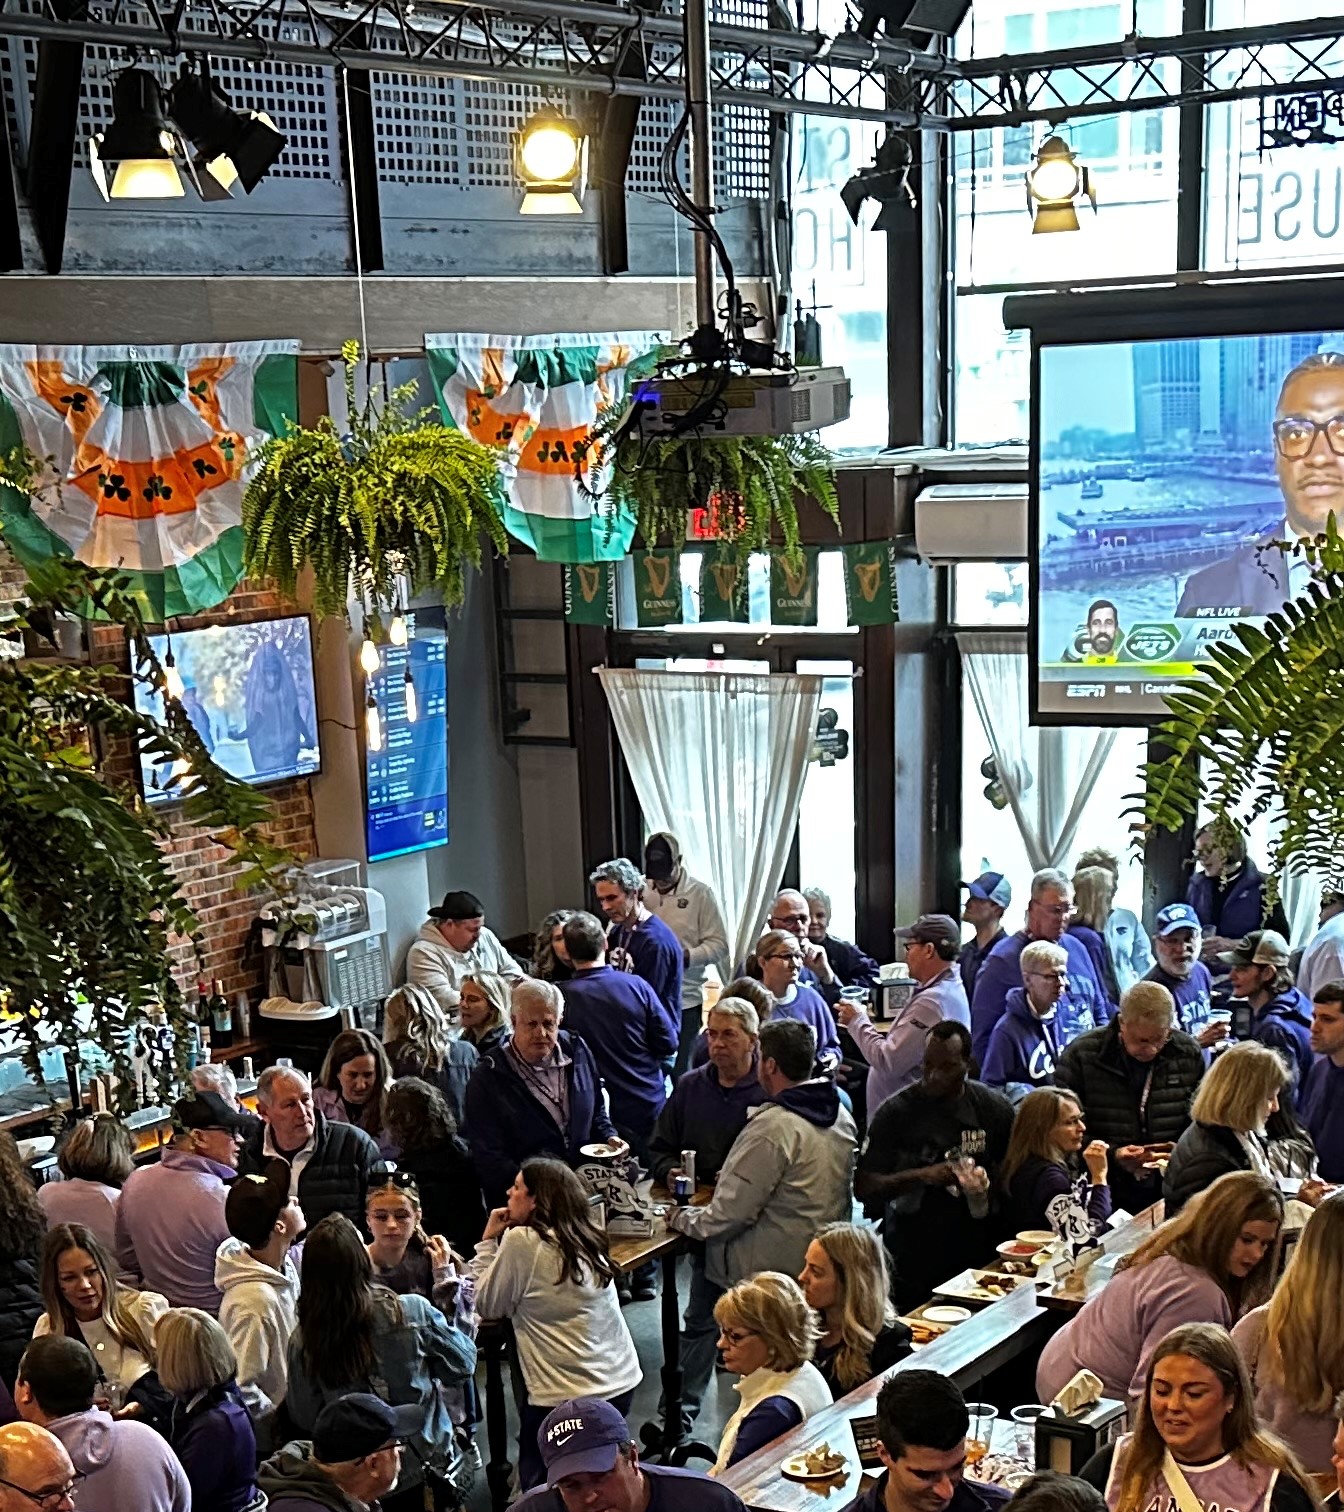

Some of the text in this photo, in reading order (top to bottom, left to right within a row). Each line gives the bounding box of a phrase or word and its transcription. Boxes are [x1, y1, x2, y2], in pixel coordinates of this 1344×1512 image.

[1196, 607, 1241, 617] NFL LIVE
[1197, 626, 1235, 640] Aaro
[1066, 684, 1106, 698] ESPN
[546, 1417, 584, 1442] K-STATE
